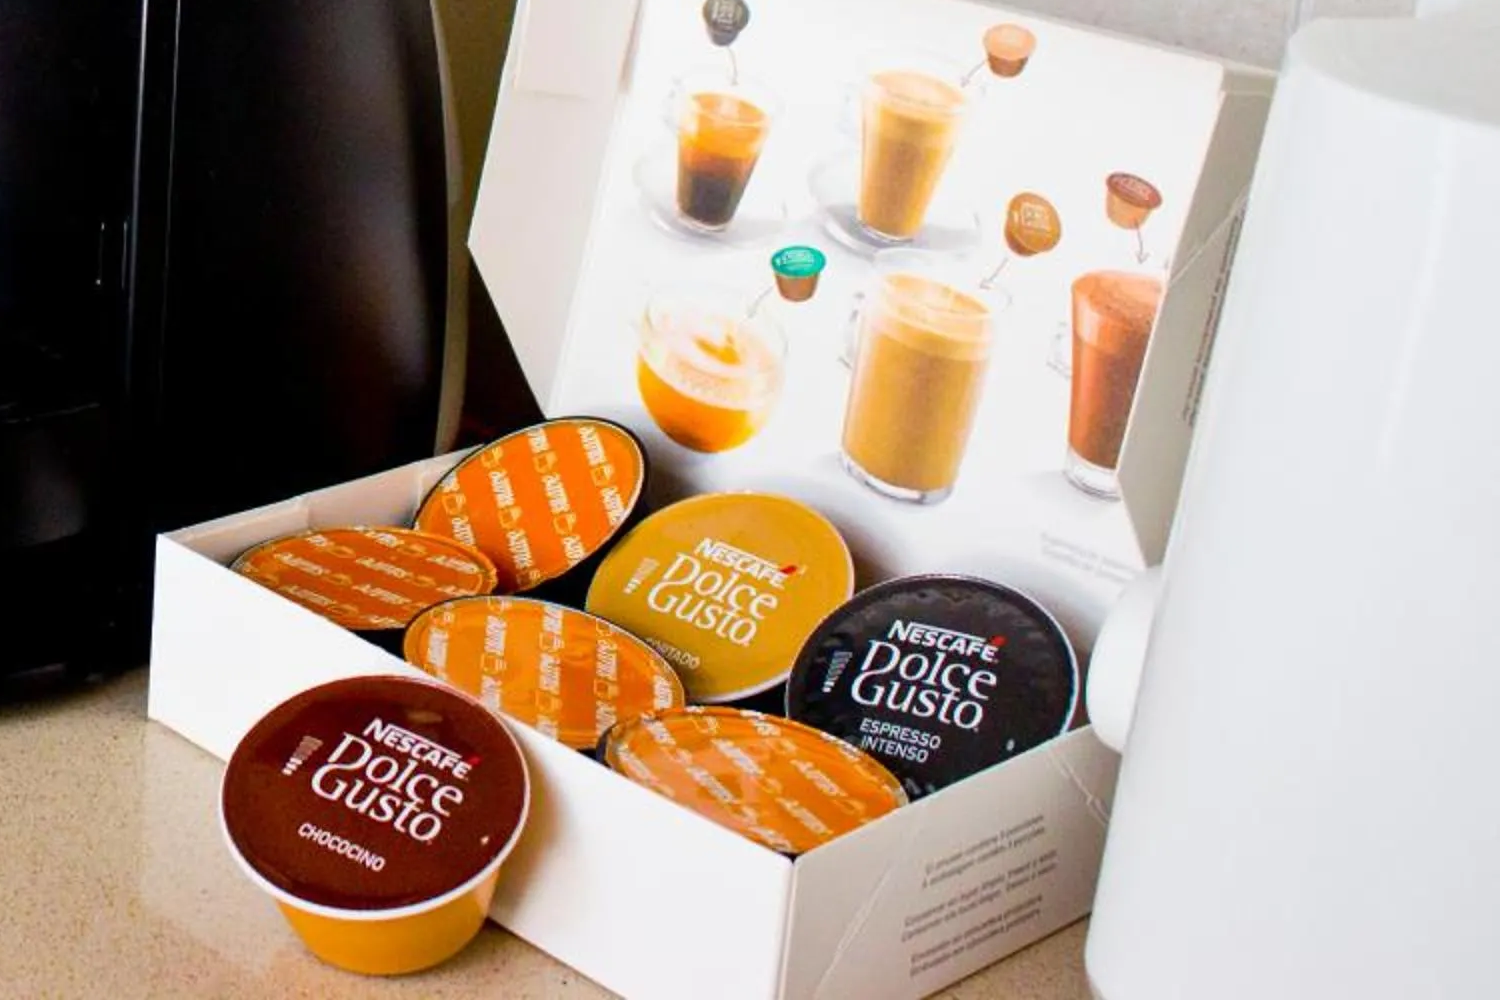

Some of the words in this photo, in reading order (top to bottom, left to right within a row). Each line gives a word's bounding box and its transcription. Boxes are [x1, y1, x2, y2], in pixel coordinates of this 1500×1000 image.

[647, 581, 758, 646] Gusto
[663, 552, 779, 620] Dolce
[851, 670, 984, 730] Gusto
[861, 639, 997, 700] Dolce
[860, 718, 941, 749] ESPRESSO
[861, 735, 929, 763] INTENSO
[311, 763, 442, 841] Gusto
[328, 732, 464, 817] Dolce
[298, 823, 386, 872] CHOCOCINO
